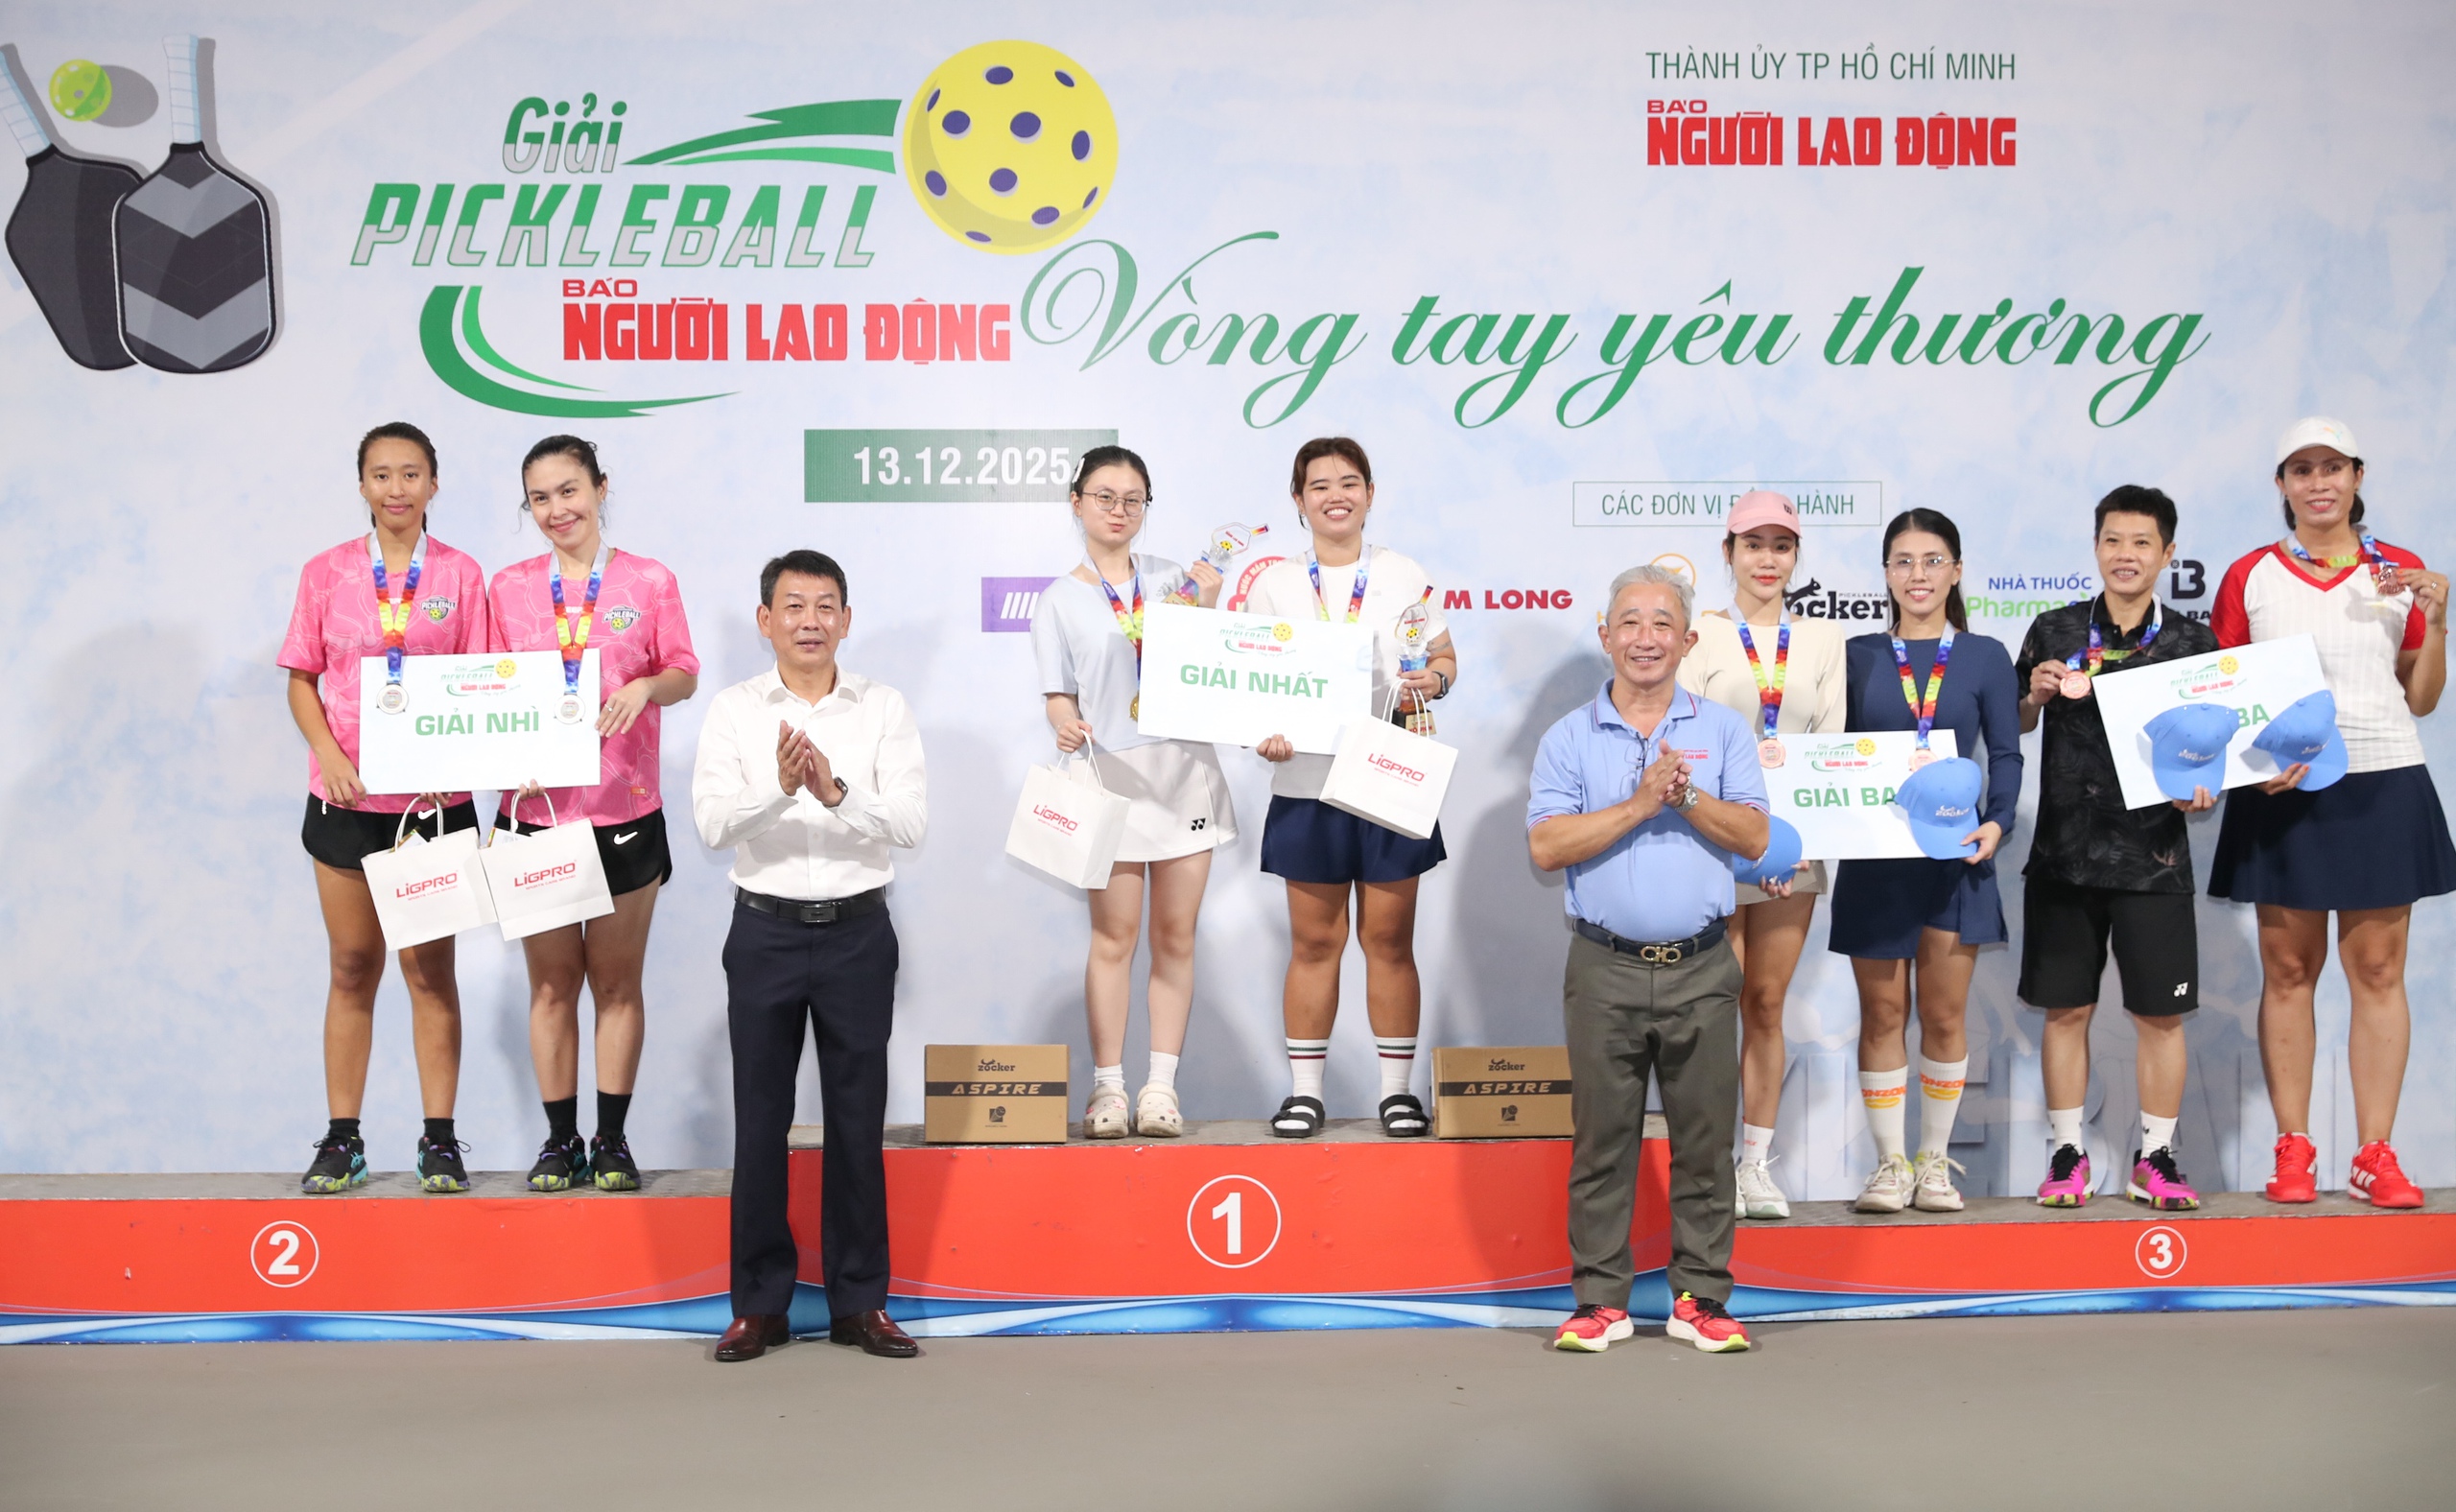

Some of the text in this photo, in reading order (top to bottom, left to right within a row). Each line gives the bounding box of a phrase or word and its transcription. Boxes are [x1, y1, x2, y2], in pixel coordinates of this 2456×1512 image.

[1645, 42, 2016, 80] THÀNH ỦY TP HỒ CHÍ MINH
[502, 92, 627, 174] Giải
[1797, 116, 1882, 166] LAO
[1894, 111, 2016, 169] ĐỘNG
[350, 182, 877, 267] PICKLEBALL
[562, 277, 638, 297] BÁO
[745, 303, 848, 361] LAO
[862, 296, 1011, 366] ĐỘNG
[1021, 230, 2213, 429] Vòng tay yêu thương
[853, 446, 1072, 485] 13.12.2025
[1601, 489, 1643, 515] CÁC
[1651, 490, 1695, 515] ĐƠN
[1704, 494, 1721, 519] VỊ
[1797, 489, 1854, 515] HÀNH
[1988, 572, 2092, 590] NHÀ THUỐC
[1484, 589, 1573, 609] LONG
[1793, 591, 1889, 620] ocker
[1180, 661, 1328, 698] GIẢI NHẤT
[415, 707, 473, 736] GIẢI
[486, 705, 539, 733] NHÌ
[1793, 781, 1899, 807] GIẢI BA
[978, 1061, 1015, 1072] zocker
[1488, 1061, 1525, 1072] zocker
[952, 1083, 1042, 1095] ASPIRE
[1463, 1081, 1552, 1095] ASPIRE
[1212, 1192, 1242, 1255] 1
[268, 1229, 300, 1276] 2
[2148, 1233, 2174, 1271] 3
